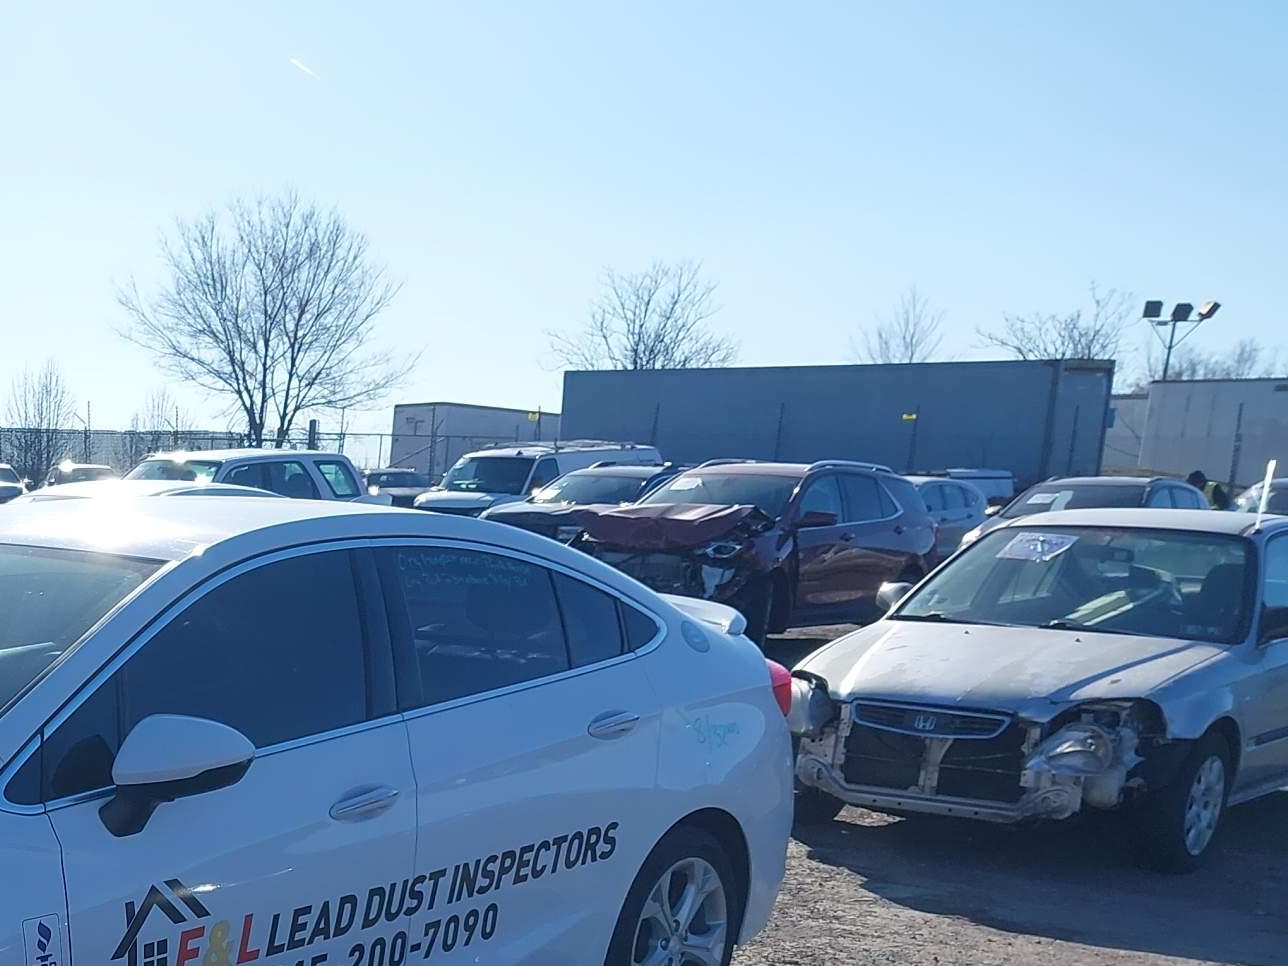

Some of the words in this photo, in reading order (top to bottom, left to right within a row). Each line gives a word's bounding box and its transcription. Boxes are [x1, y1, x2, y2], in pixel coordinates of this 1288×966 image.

[266, 895, 358, 957] LEAD
[361, 868, 447, 931] DUST
[447, 822, 619, 905] INSPECTORS
